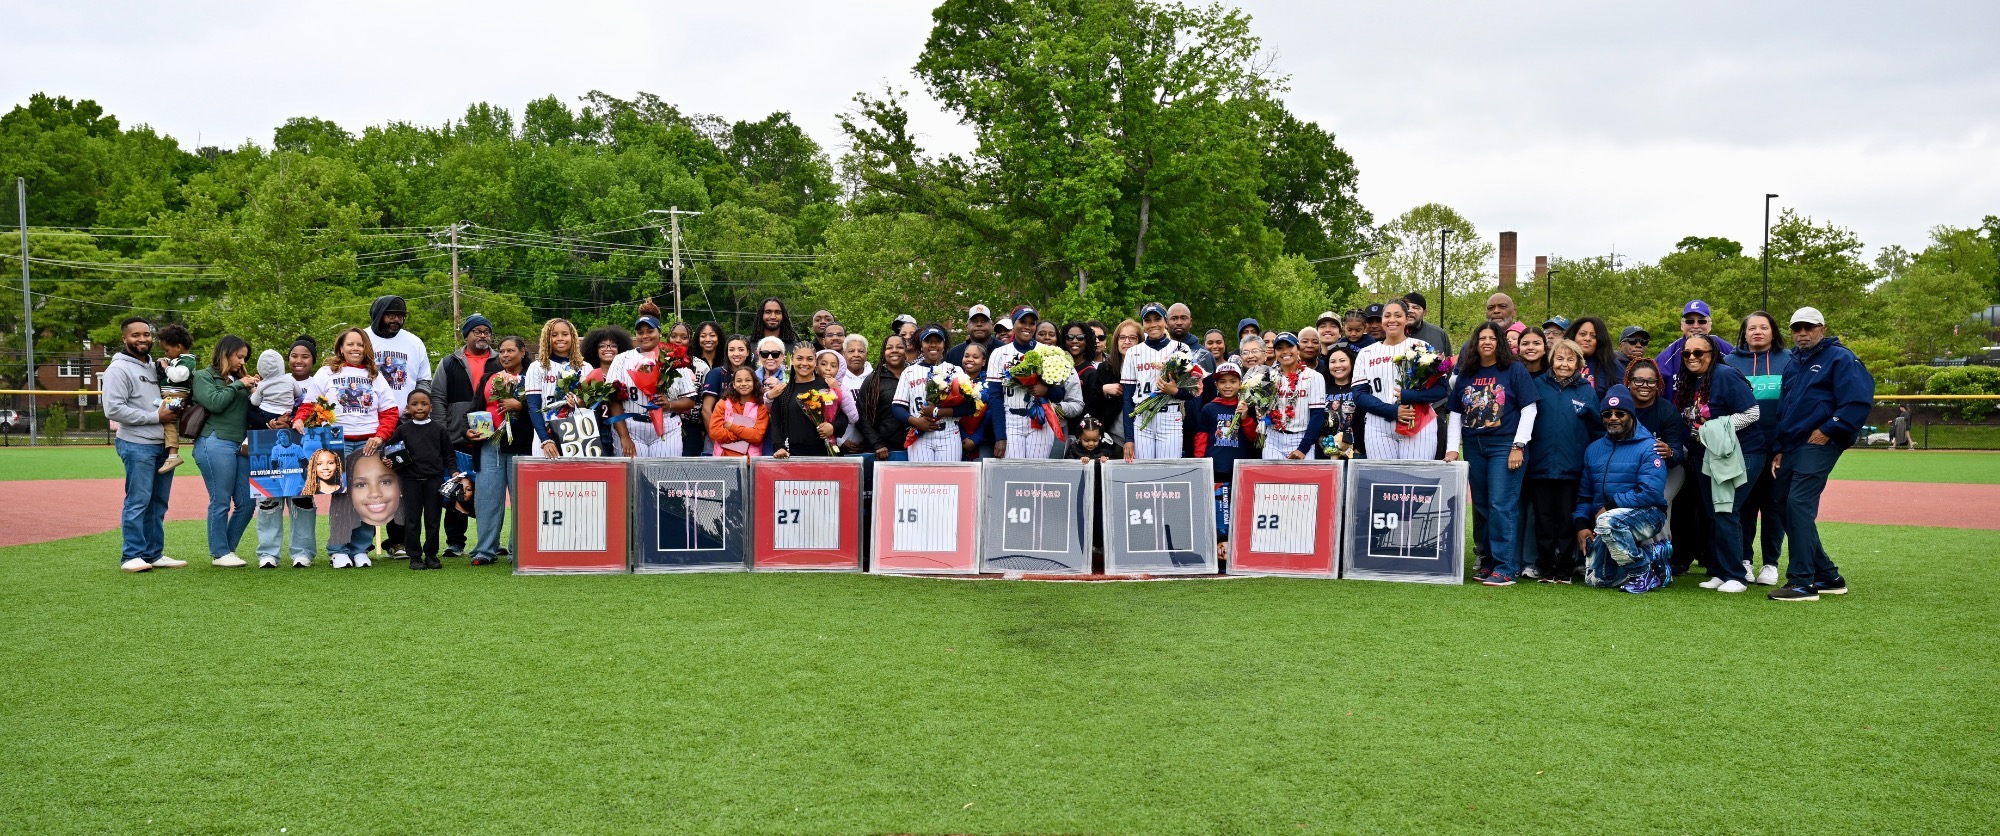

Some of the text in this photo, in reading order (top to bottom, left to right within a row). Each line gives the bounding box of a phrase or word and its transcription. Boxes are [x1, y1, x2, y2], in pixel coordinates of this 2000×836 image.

[1368, 356, 1394, 368] HOW
[1472, 377, 1496, 386] JULIA
[630, 386, 638, 402] 8
[560, 416, 594, 442] 20
[668, 489, 716, 497] HOWARD
[1016, 489, 1061, 498] HOWARD
[1136, 491, 1181, 499] HOWARD
[1383, 493, 1432, 503] HOWARD
[542, 510, 563, 525] 12
[778, 509, 800, 524] 27
[898, 509, 917, 523] 16
[1007, 507, 1031, 523] 40
[1129, 508, 1154, 525] 24
[1257, 514, 1279, 529] 22
[1373, 513, 1398, 529] 50
